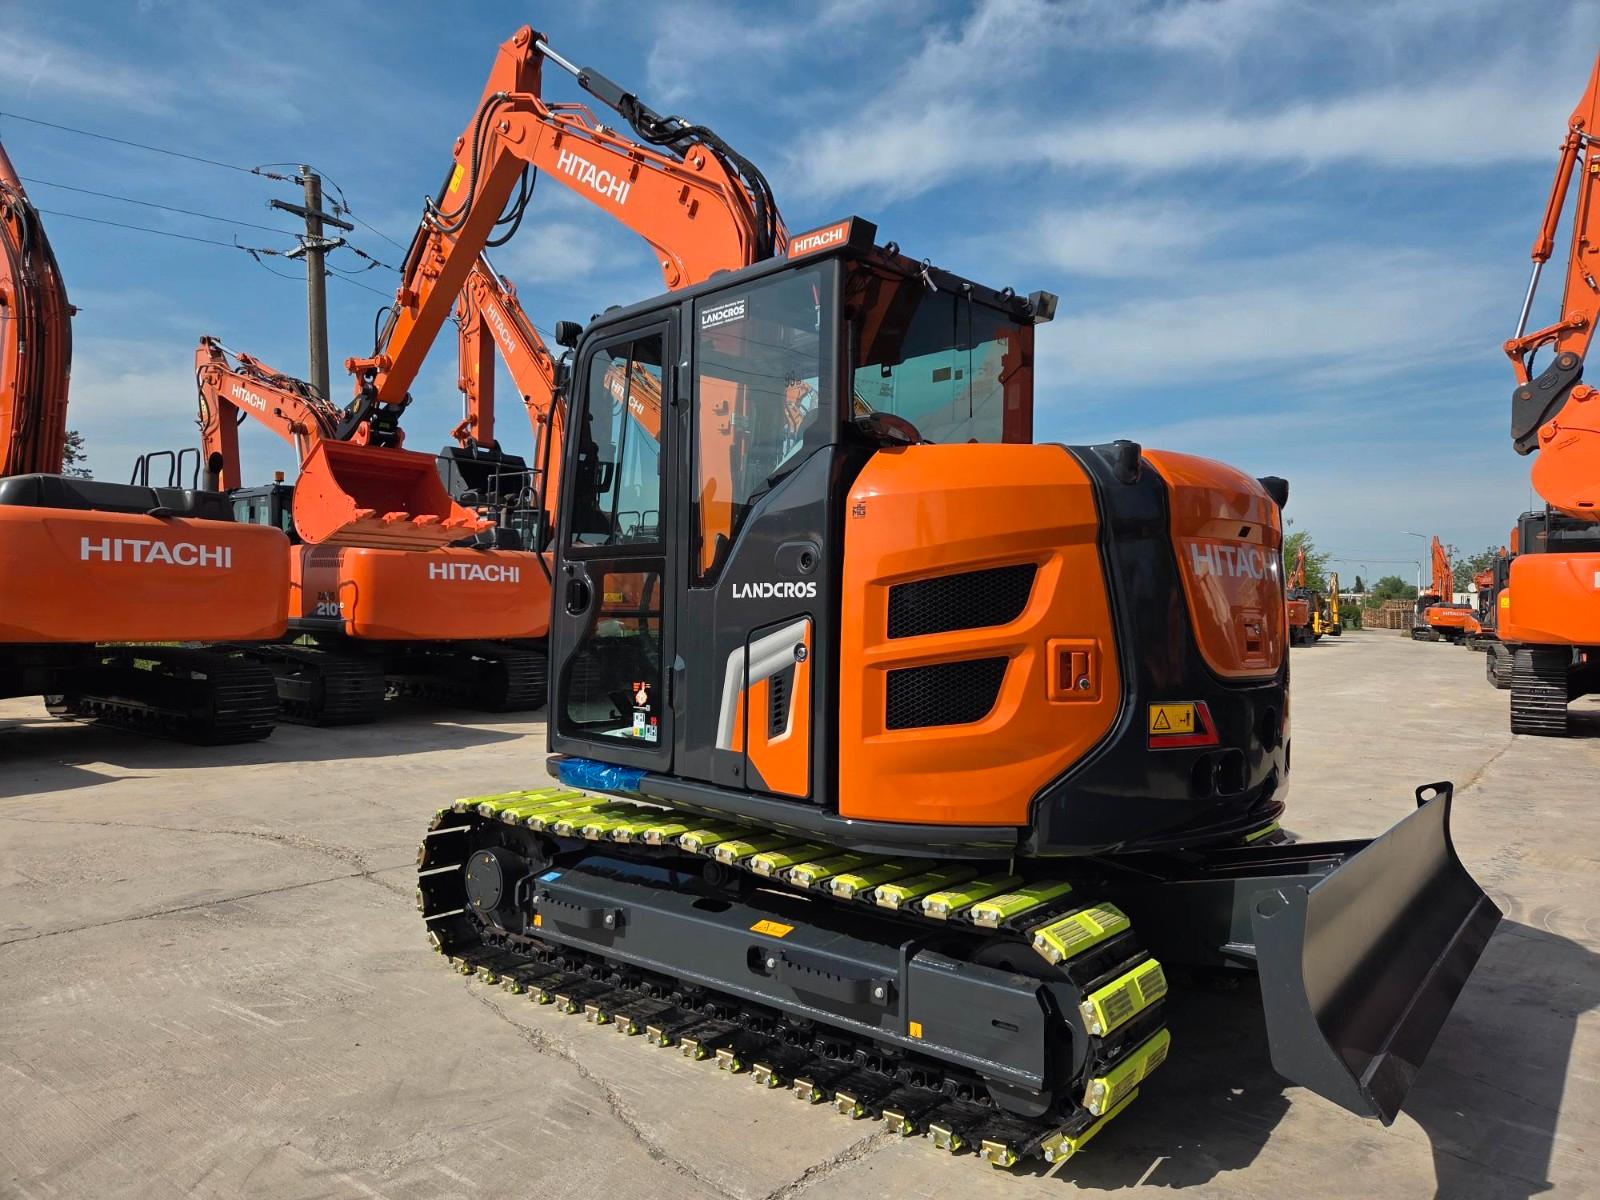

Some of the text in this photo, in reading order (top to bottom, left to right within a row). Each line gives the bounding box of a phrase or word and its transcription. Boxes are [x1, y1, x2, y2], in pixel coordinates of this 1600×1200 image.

[557, 148, 630, 205] HITACHI
[794, 228, 843, 253] HITACHI
[702, 304, 744, 325] LANDCROS
[487, 303, 517, 354] HITACHI
[231, 383, 267, 412] HITACHI
[80, 536, 232, 568] HITACHI
[428, 562, 520, 583] HITACHI
[732, 581, 817, 599] LANDCROS
